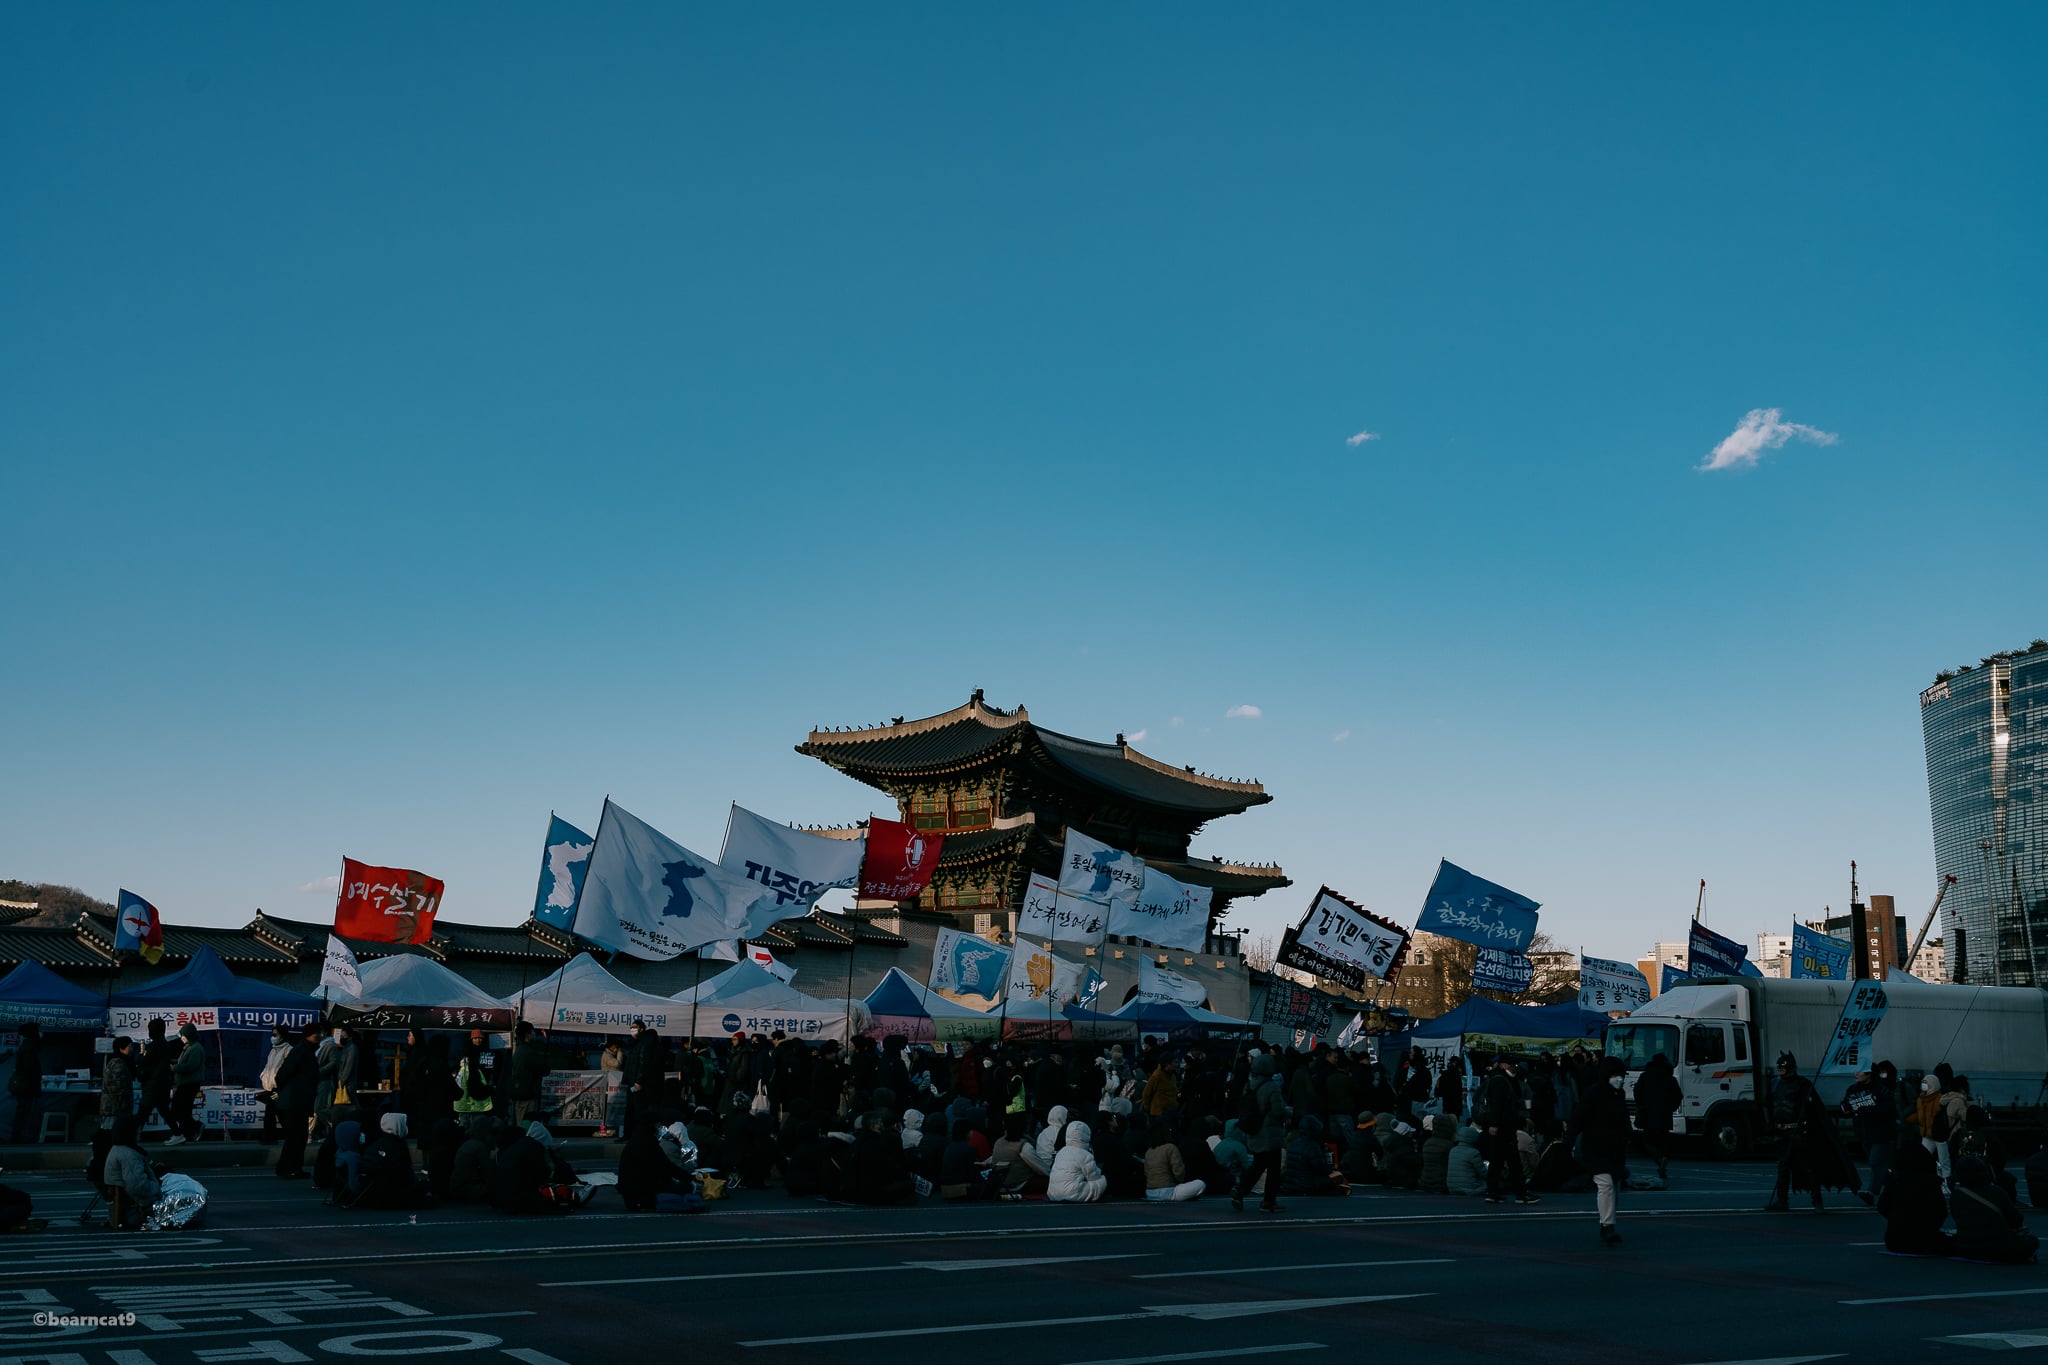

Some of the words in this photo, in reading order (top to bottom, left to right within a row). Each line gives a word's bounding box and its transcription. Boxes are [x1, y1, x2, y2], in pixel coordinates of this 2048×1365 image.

[1071, 854, 1140, 889] 통일시대연구원
[347, 881, 435, 917] 예수살기
[1171, 899, 1190, 915] 왜?
[1437, 901, 1522, 946] 한국작가회의
[176, 1011, 215, 1026] 흥사단
[442, 1009, 494, 1027] 촛불교회
[746, 1017, 823, 1033] 자주연합(준)
